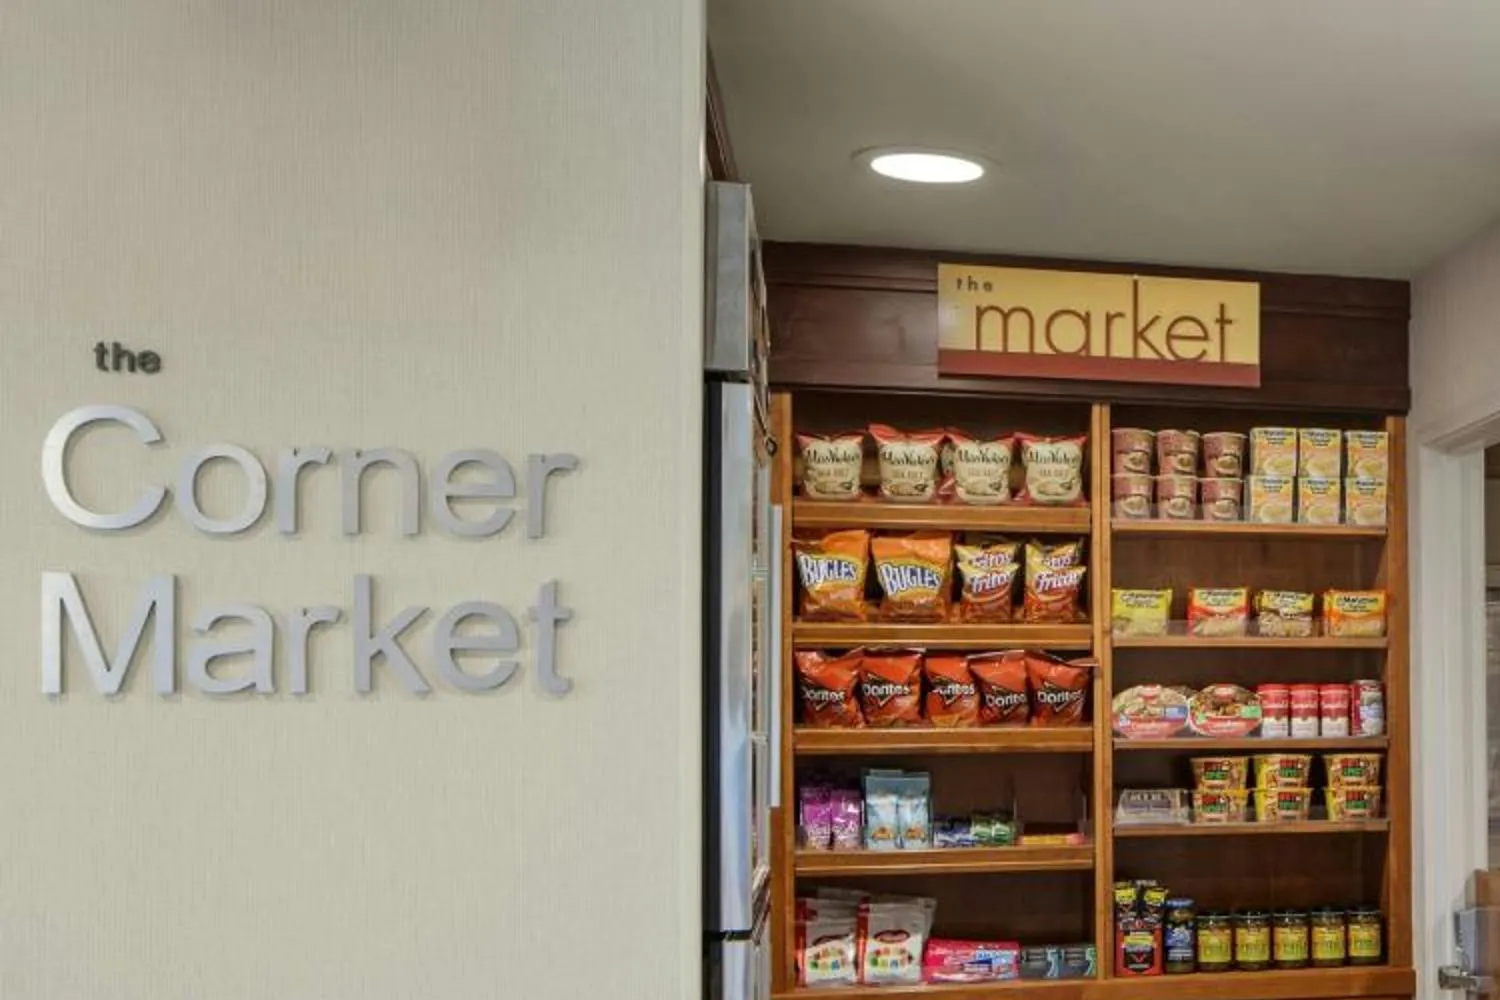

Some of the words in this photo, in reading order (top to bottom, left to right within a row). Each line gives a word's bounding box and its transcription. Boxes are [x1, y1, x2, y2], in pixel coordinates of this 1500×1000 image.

[956, 276, 994, 293] the
[975, 279, 1233, 362] market
[93, 341, 163, 374] the
[41, 404, 580, 539] Corner
[799, 553, 858, 588] BUGLES
[879, 562, 941, 597] BUGLES
[41, 571, 574, 699] Market
[862, 683, 911, 697] Doritos
[985, 693, 1026, 707] Dorito
